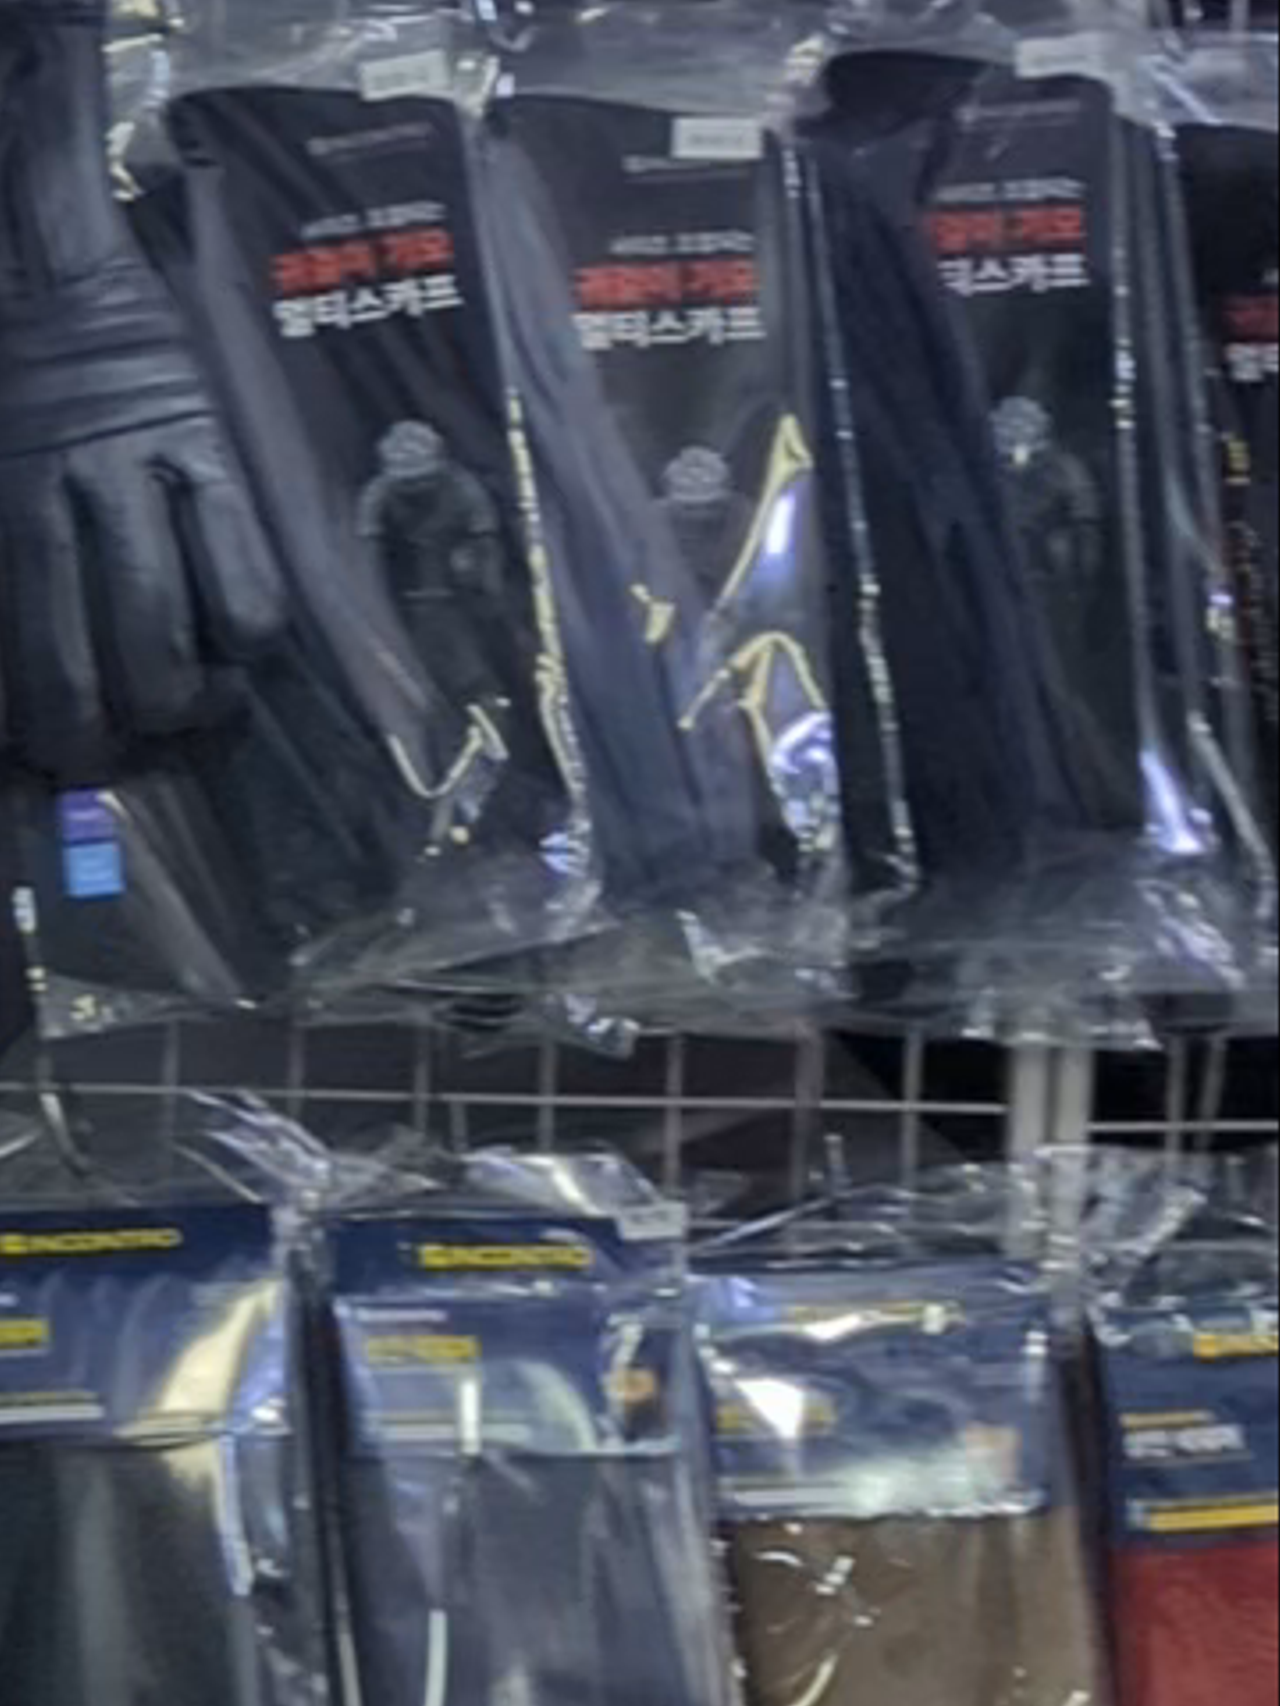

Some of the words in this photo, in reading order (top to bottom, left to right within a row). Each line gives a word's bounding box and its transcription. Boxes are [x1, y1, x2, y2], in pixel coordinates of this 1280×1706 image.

[936, 253, 1091, 297] 티스카프
[272, 273, 465, 338] 멀티스카프
[570, 305, 768, 351] 멀티스카프
